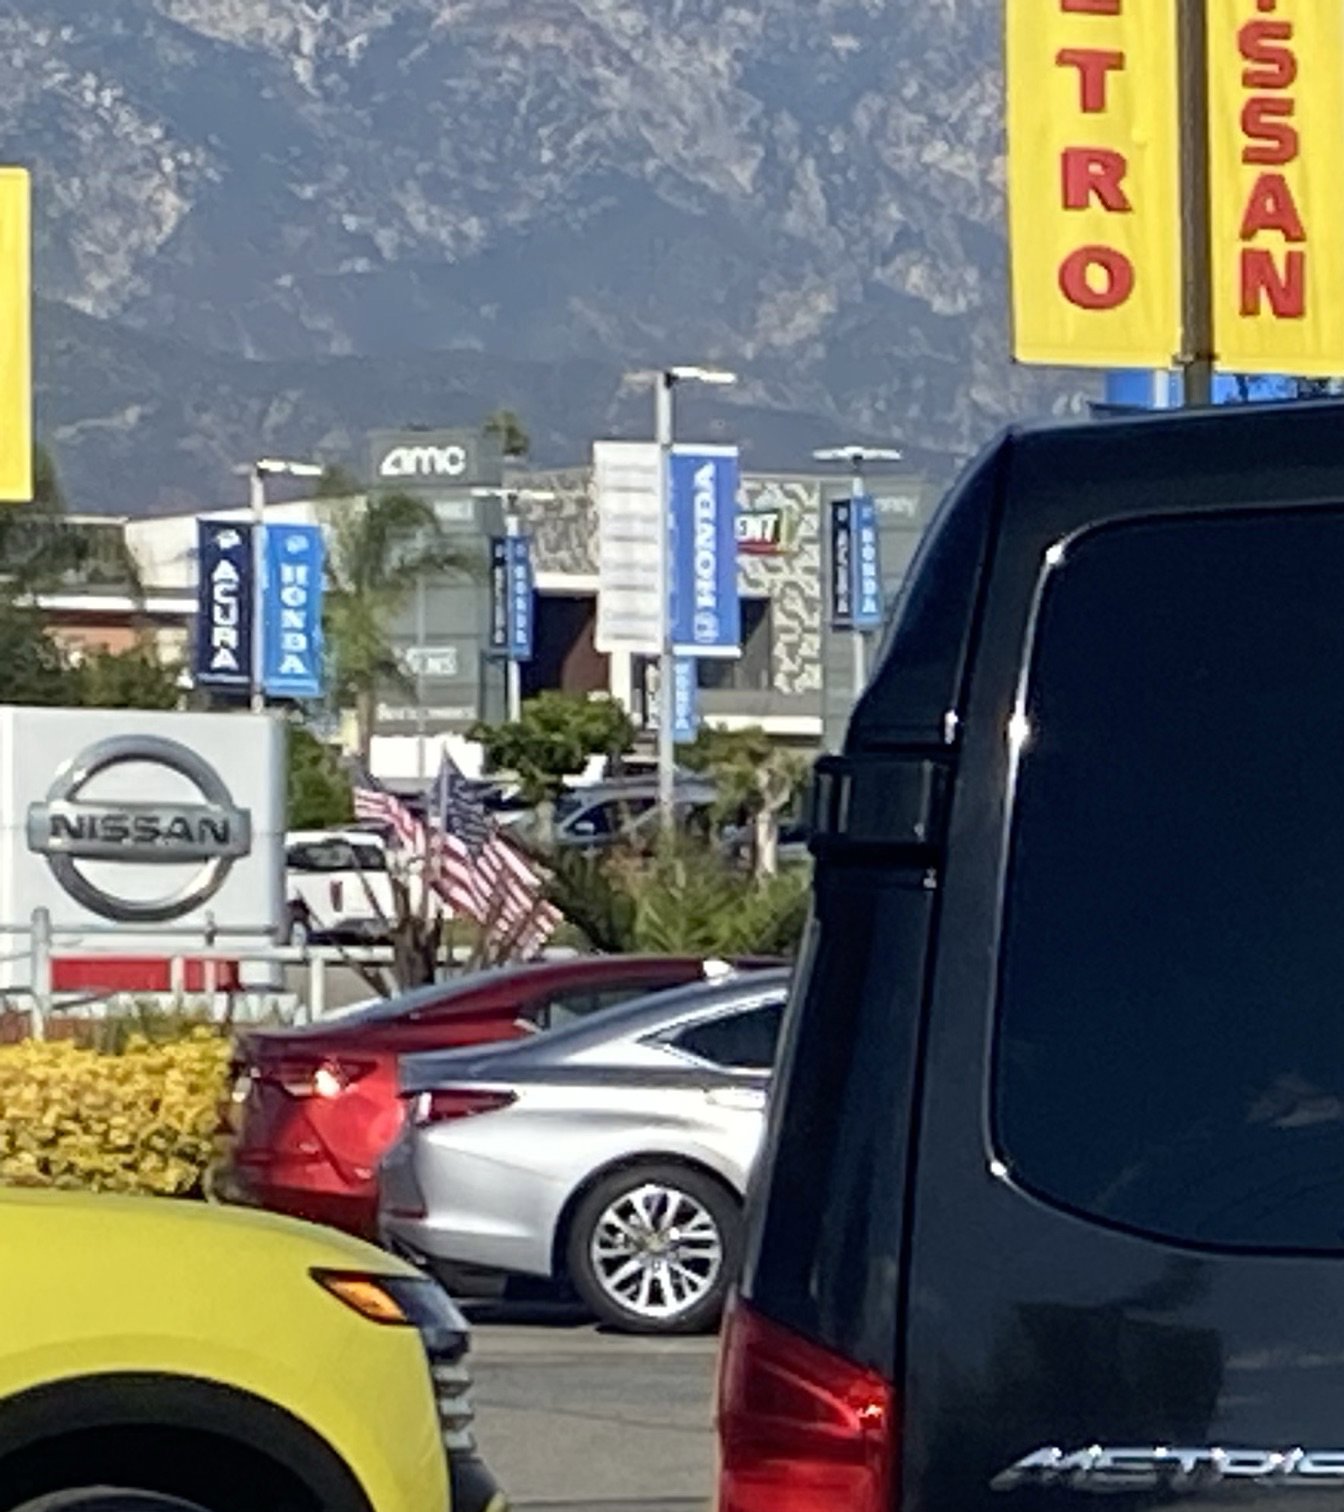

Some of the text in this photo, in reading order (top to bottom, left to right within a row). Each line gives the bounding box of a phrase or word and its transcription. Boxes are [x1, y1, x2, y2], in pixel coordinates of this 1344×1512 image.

[1055, 0, 1134, 311] TRO
[1238, 0, 1306, 318] SSAN
[694, 461, 717, 609] HONDA
[210, 559, 240, 671] ACURA
[280, 563, 310, 674] HONDA
[50, 813, 231, 845] NISSAN
